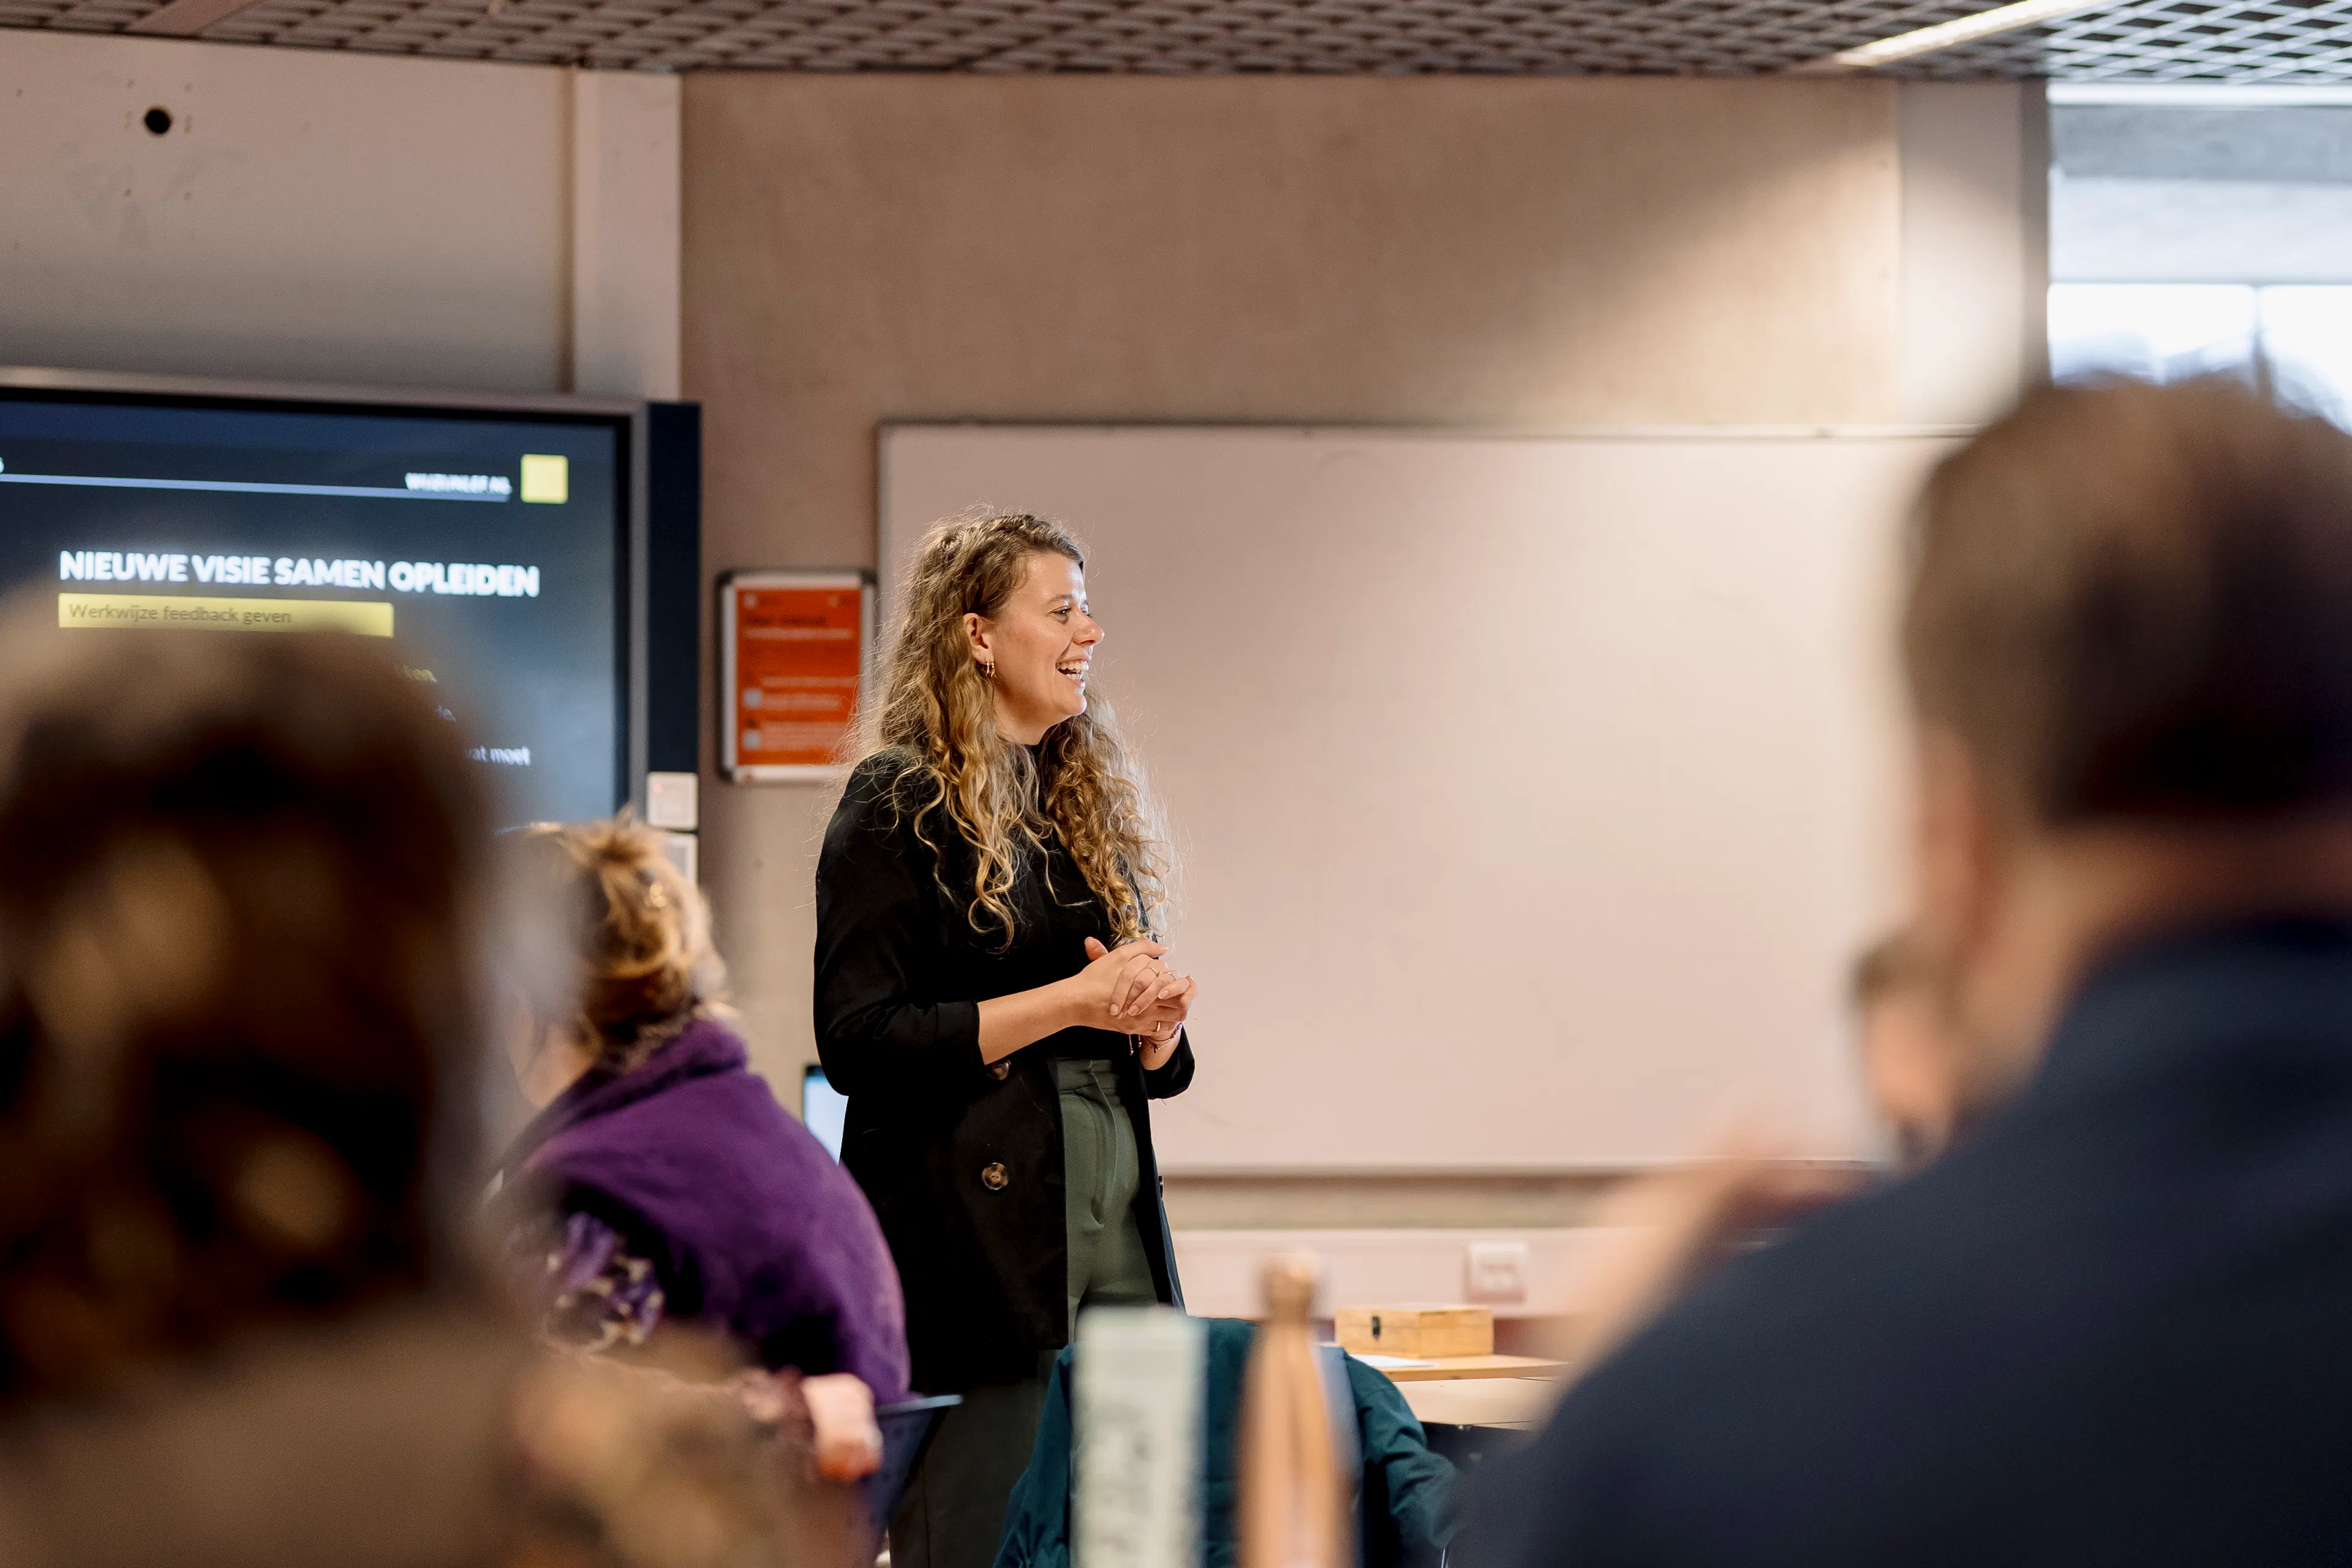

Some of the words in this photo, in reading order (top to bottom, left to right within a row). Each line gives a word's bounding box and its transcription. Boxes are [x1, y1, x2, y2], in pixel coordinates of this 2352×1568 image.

[60, 550, 189, 582] NIEUWE
[190, 554, 272, 586] VISIE
[273, 557, 386, 591] SAMEN
[387, 560, 541, 598] OPLEIDEN
[69, 603, 158, 622] Werkwijze
[163, 605, 238, 623] feedback
[242, 611, 293, 625] geven
[489, 746, 531, 766] moet
